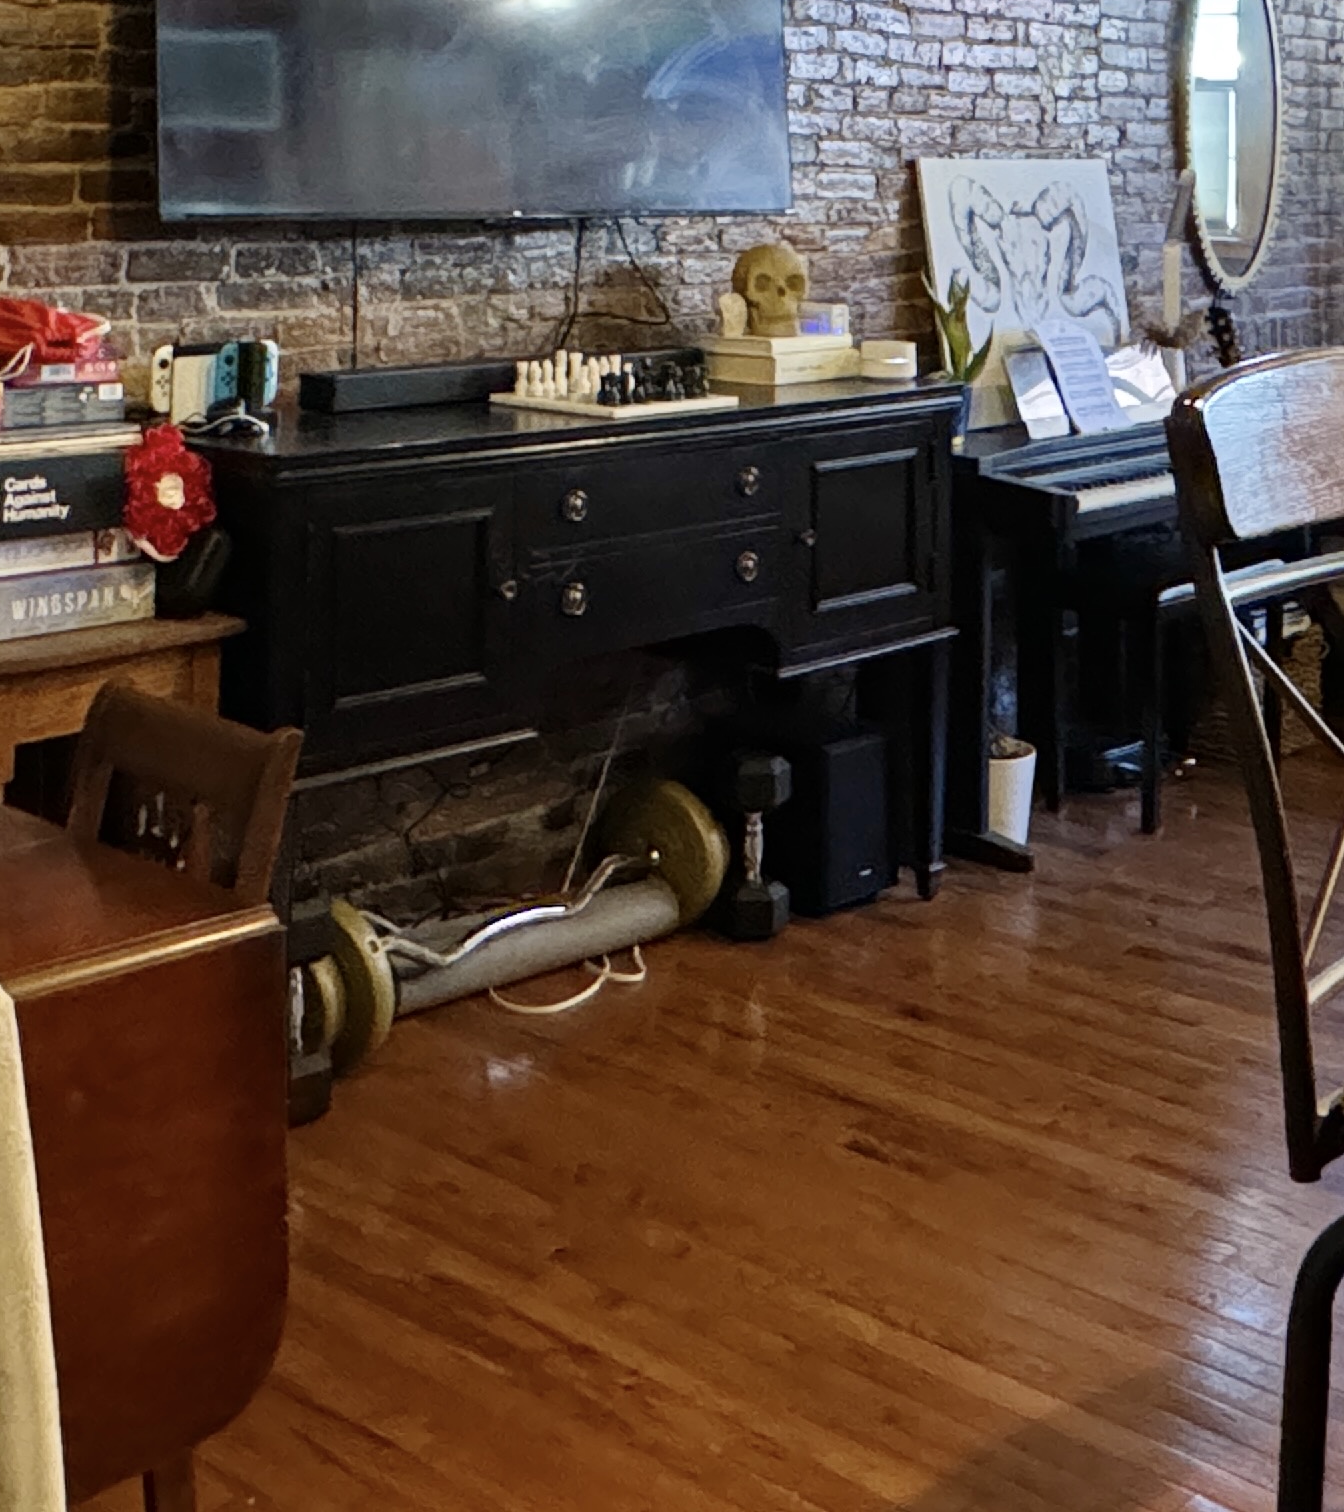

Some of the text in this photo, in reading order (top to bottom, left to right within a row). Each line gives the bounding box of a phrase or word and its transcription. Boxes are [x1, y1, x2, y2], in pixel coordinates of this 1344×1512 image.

[4, 474, 47, 492] Cards
[3, 489, 56, 510] Against
[2, 504, 71, 523] Humanity
[11, 585, 115, 621] WINGSPAN
